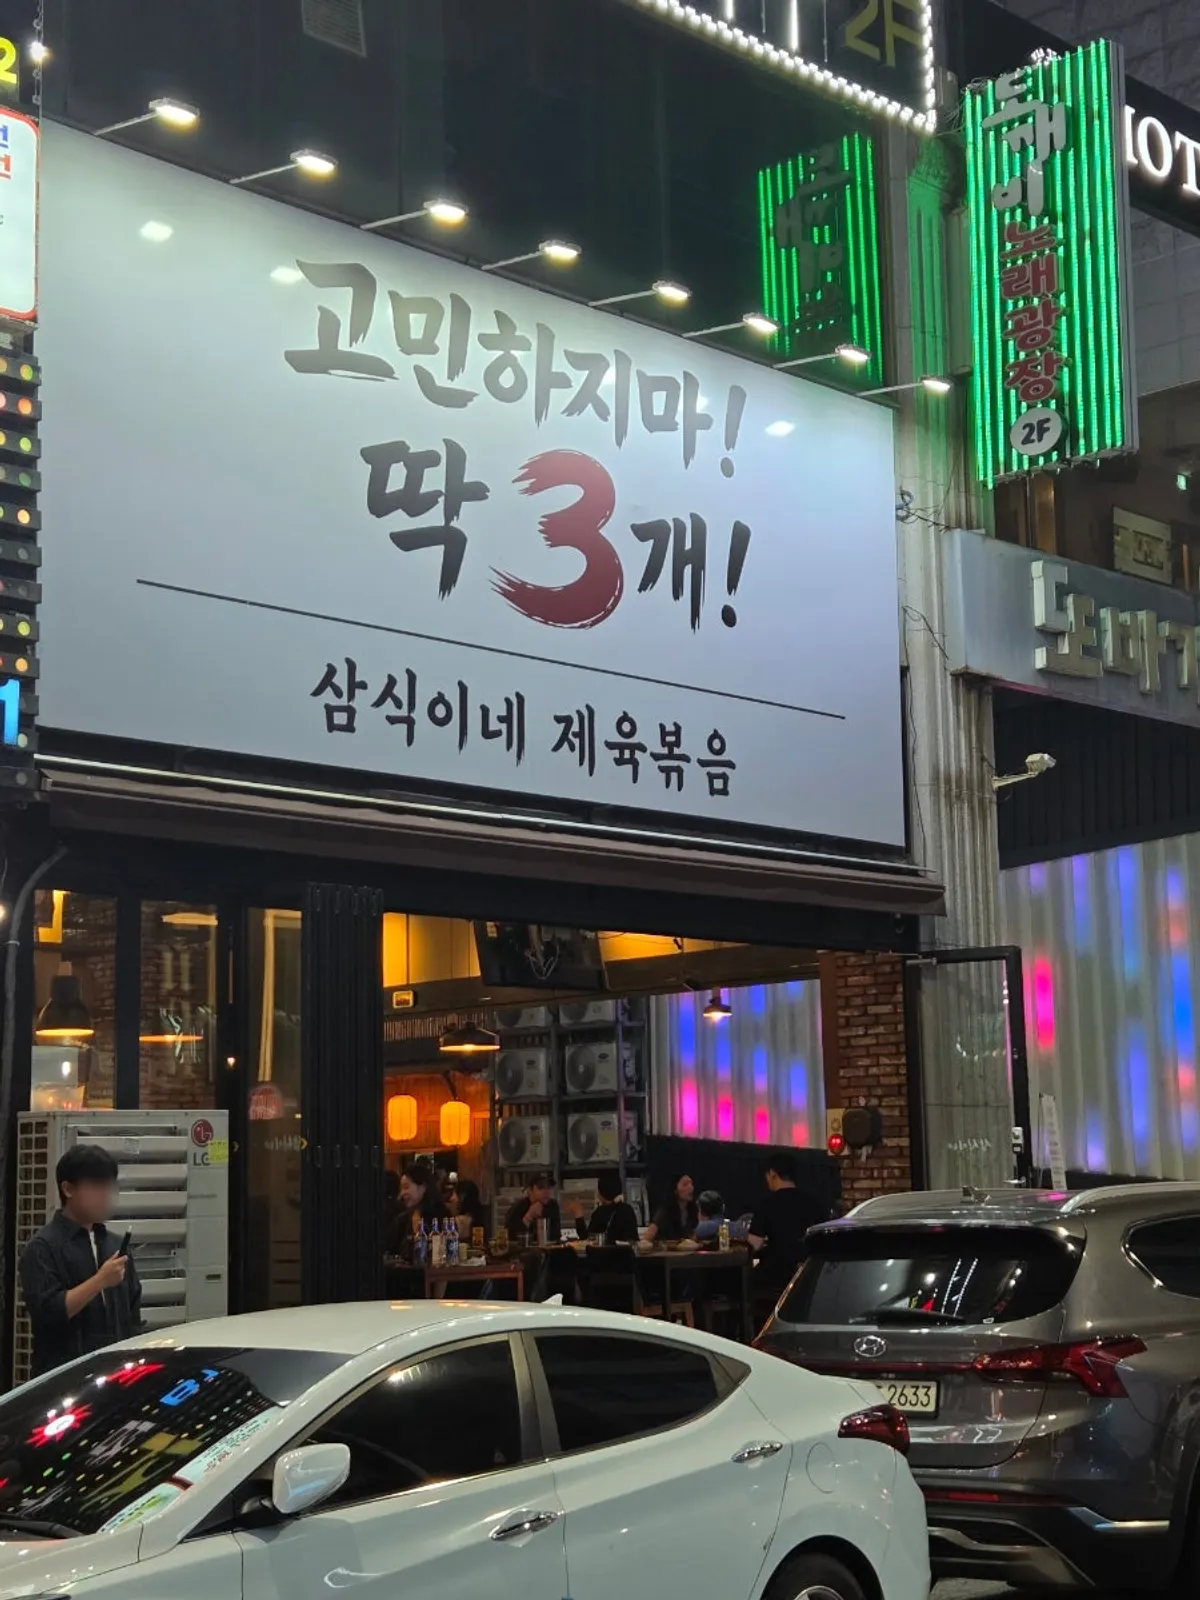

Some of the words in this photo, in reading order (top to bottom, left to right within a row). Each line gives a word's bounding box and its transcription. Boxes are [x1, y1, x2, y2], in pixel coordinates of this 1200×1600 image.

[284, 259, 747, 479] 고민하지마!
[1000, 220, 1063, 403] 노래광장
[1020, 416, 1052, 447] 2F
[360, 437, 491, 601] 딱
[310, 656, 526, 768] 삼식이네
[550, 702, 737, 798] 제육볶음
[887, 1384, 931, 1408] 2633
